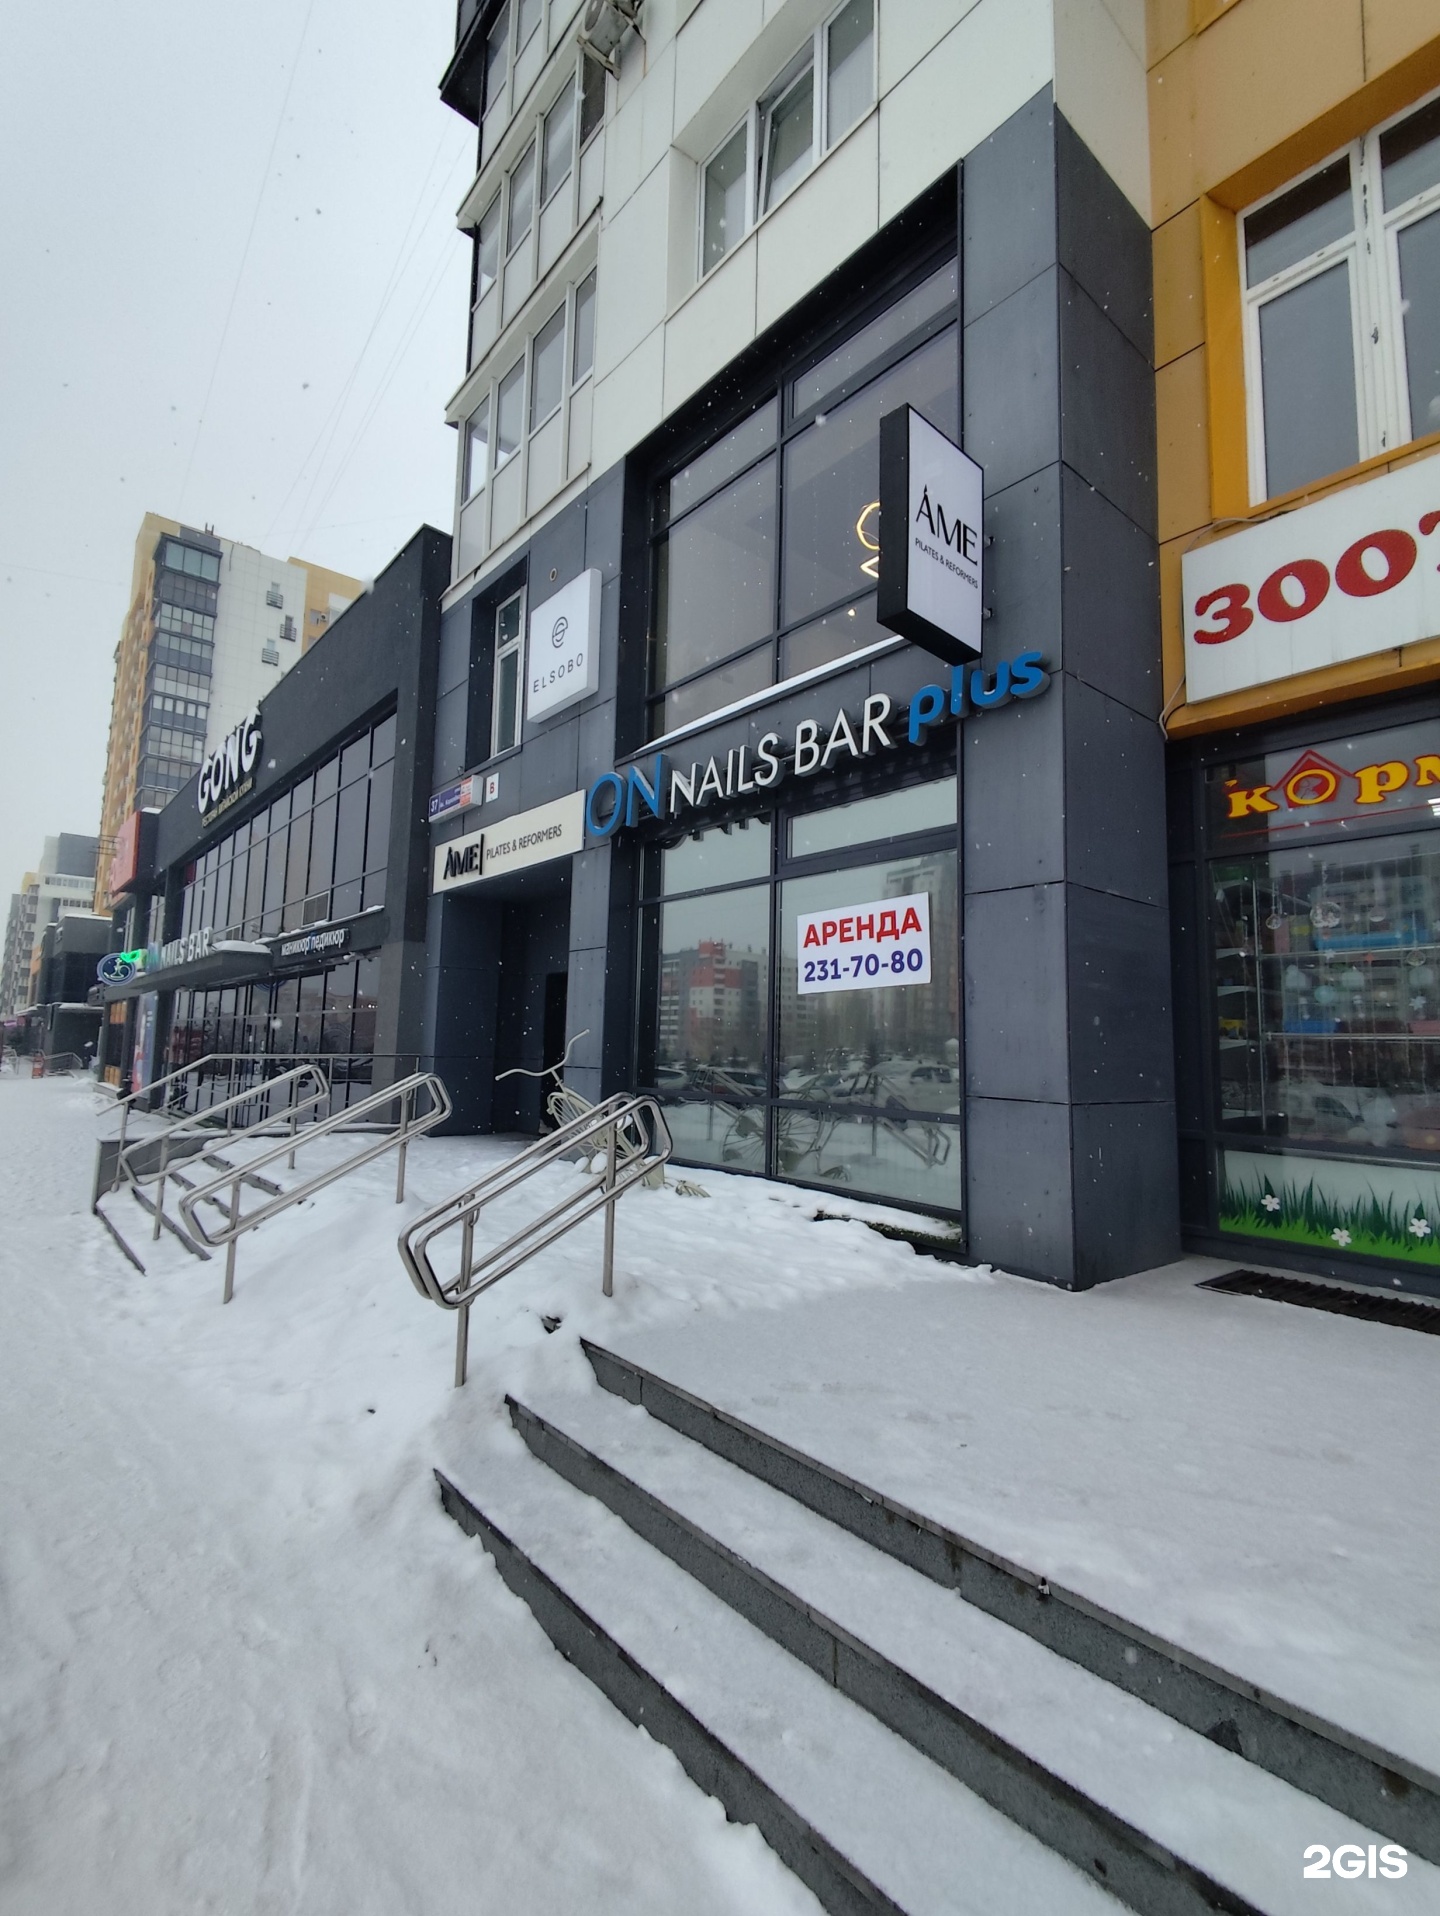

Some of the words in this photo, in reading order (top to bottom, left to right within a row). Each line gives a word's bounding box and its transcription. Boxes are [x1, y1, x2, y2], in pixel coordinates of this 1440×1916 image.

[914, 537, 940, 561] PILATES
[944, 559, 979, 589] REFORMERS
[533, 652, 584, 693] ELSOBO
[197, 706, 263, 814] GONG
[586, 755, 664, 837] ON
[669, 731, 781, 813] NAILS
[794, 694, 894, 778] BAR
[908, 651, 1045, 746] plus
[486, 841, 511, 860] PILATES
[511, 839, 517, 851] &
[518, 824, 562, 850] REFORMERS
[187, 927, 211, 961] BAR
[311, 929, 345, 952] педикюр
[803, 906, 922, 948] АРЕНДА
[803, 949, 923, 984] 231-70-80
